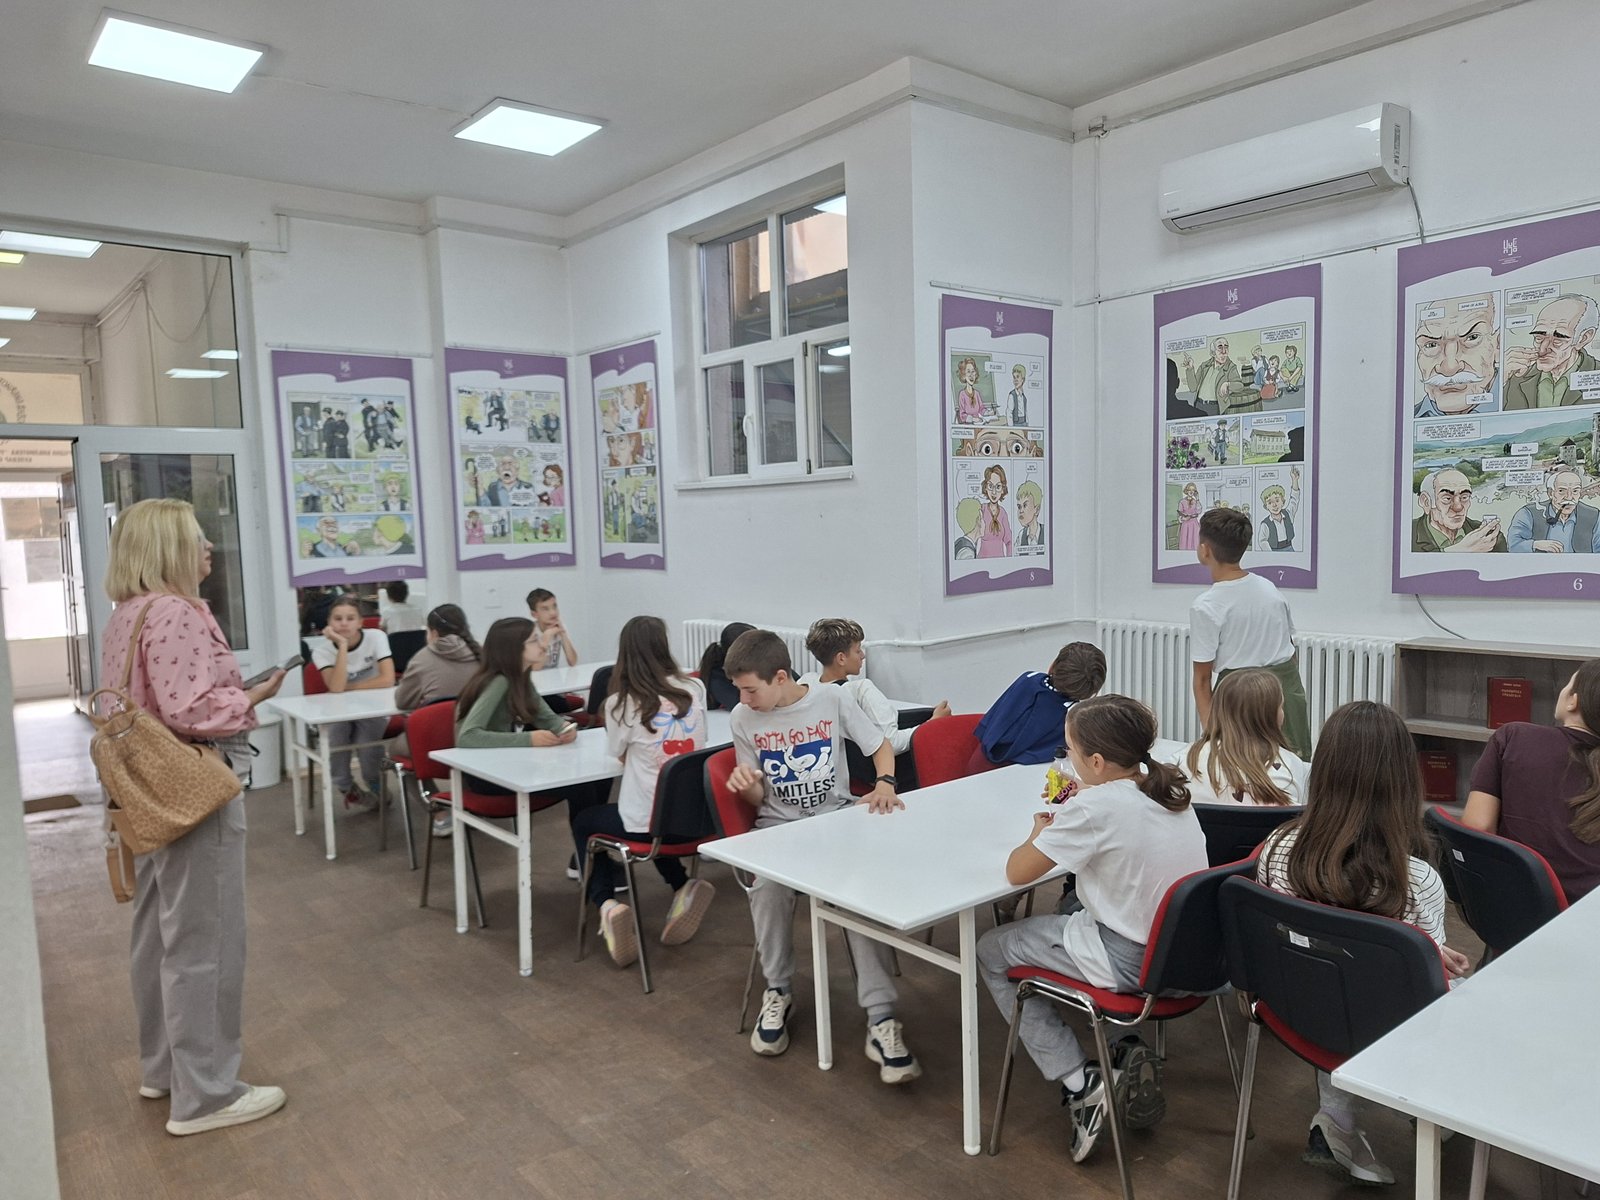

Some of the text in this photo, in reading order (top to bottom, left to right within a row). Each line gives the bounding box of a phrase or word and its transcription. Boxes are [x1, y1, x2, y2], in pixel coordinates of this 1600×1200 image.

[1029, 571, 1035, 581] 8
[1277, 570, 1285, 581] 7
[1572, 578, 1583, 591] 6
[754, 720, 832, 752] GOTTA GO FAST
